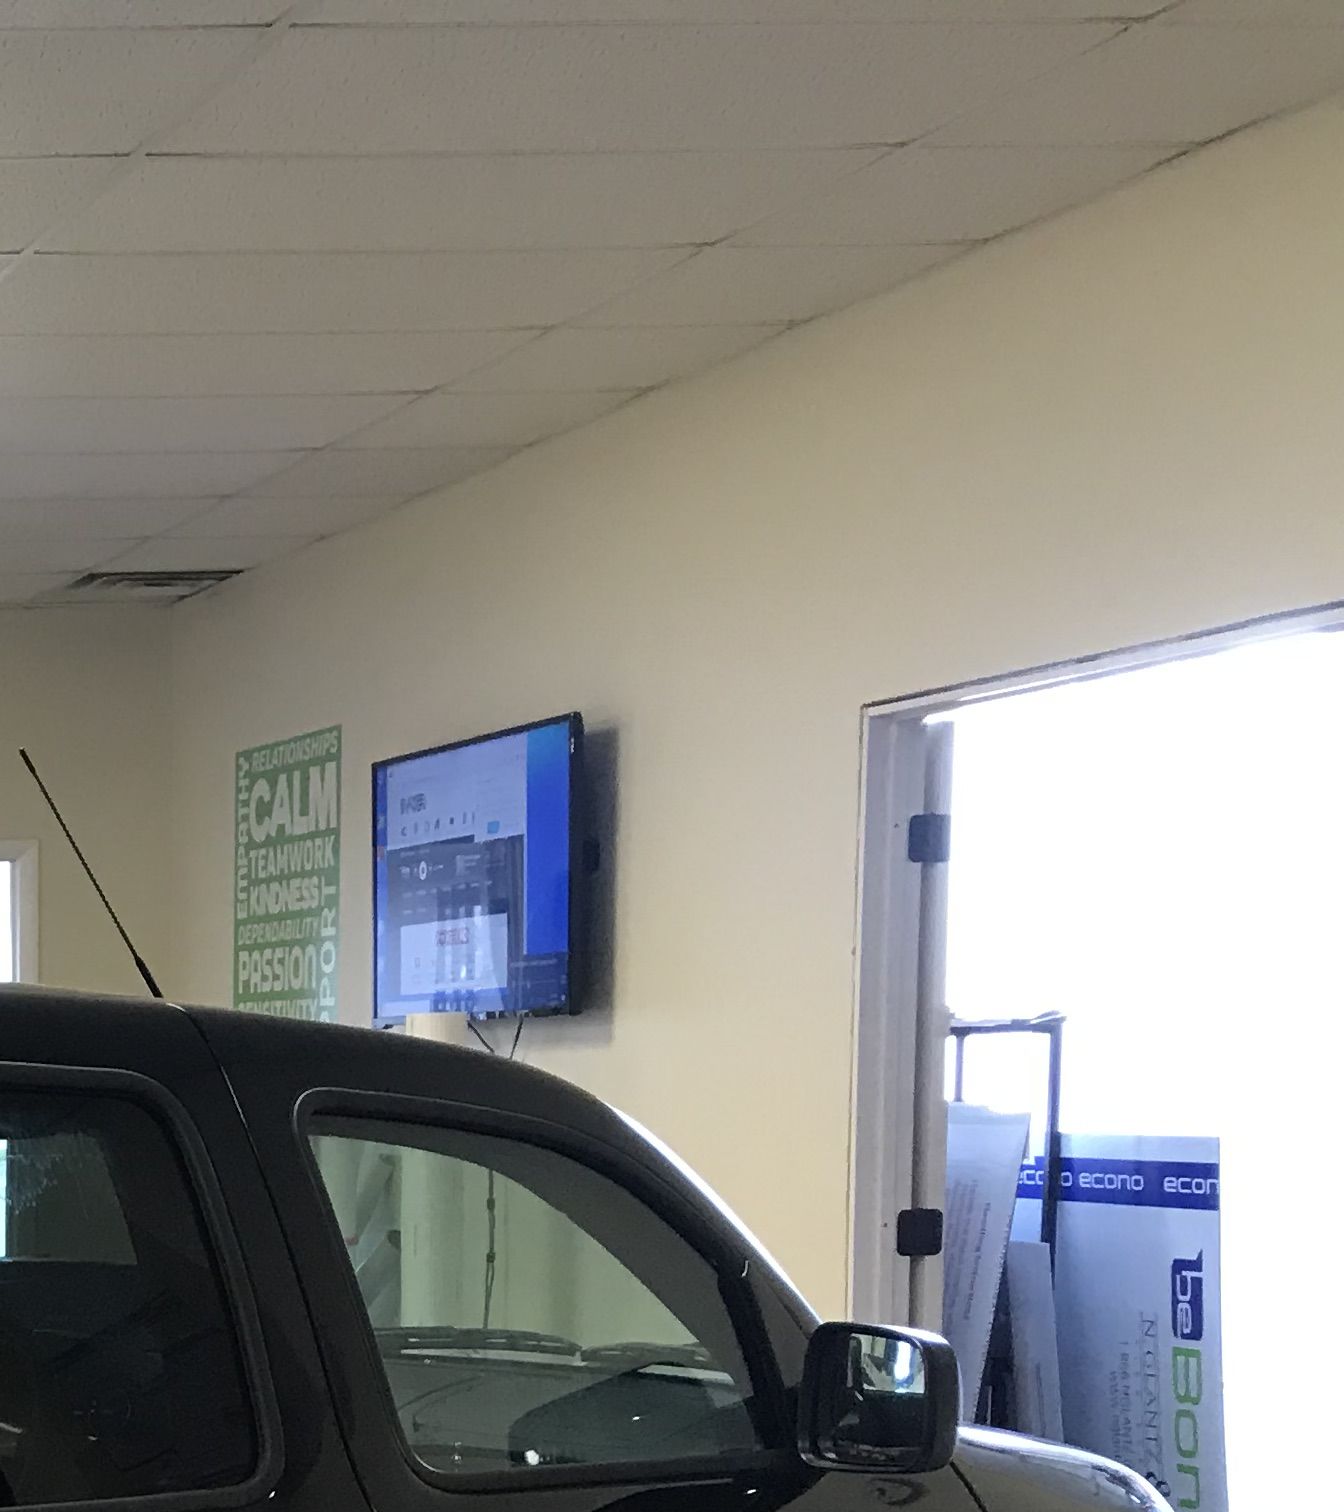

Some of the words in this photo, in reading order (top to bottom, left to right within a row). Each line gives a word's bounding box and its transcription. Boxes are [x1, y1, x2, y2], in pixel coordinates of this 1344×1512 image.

[249, 761, 337, 842] CALM
[249, 834, 335, 879] TEAMWORK
[250, 876, 319, 916] KINDNESS
[1079, 1172, 1145, 1192] econo
[1164, 1175, 1219, 1196] econ
